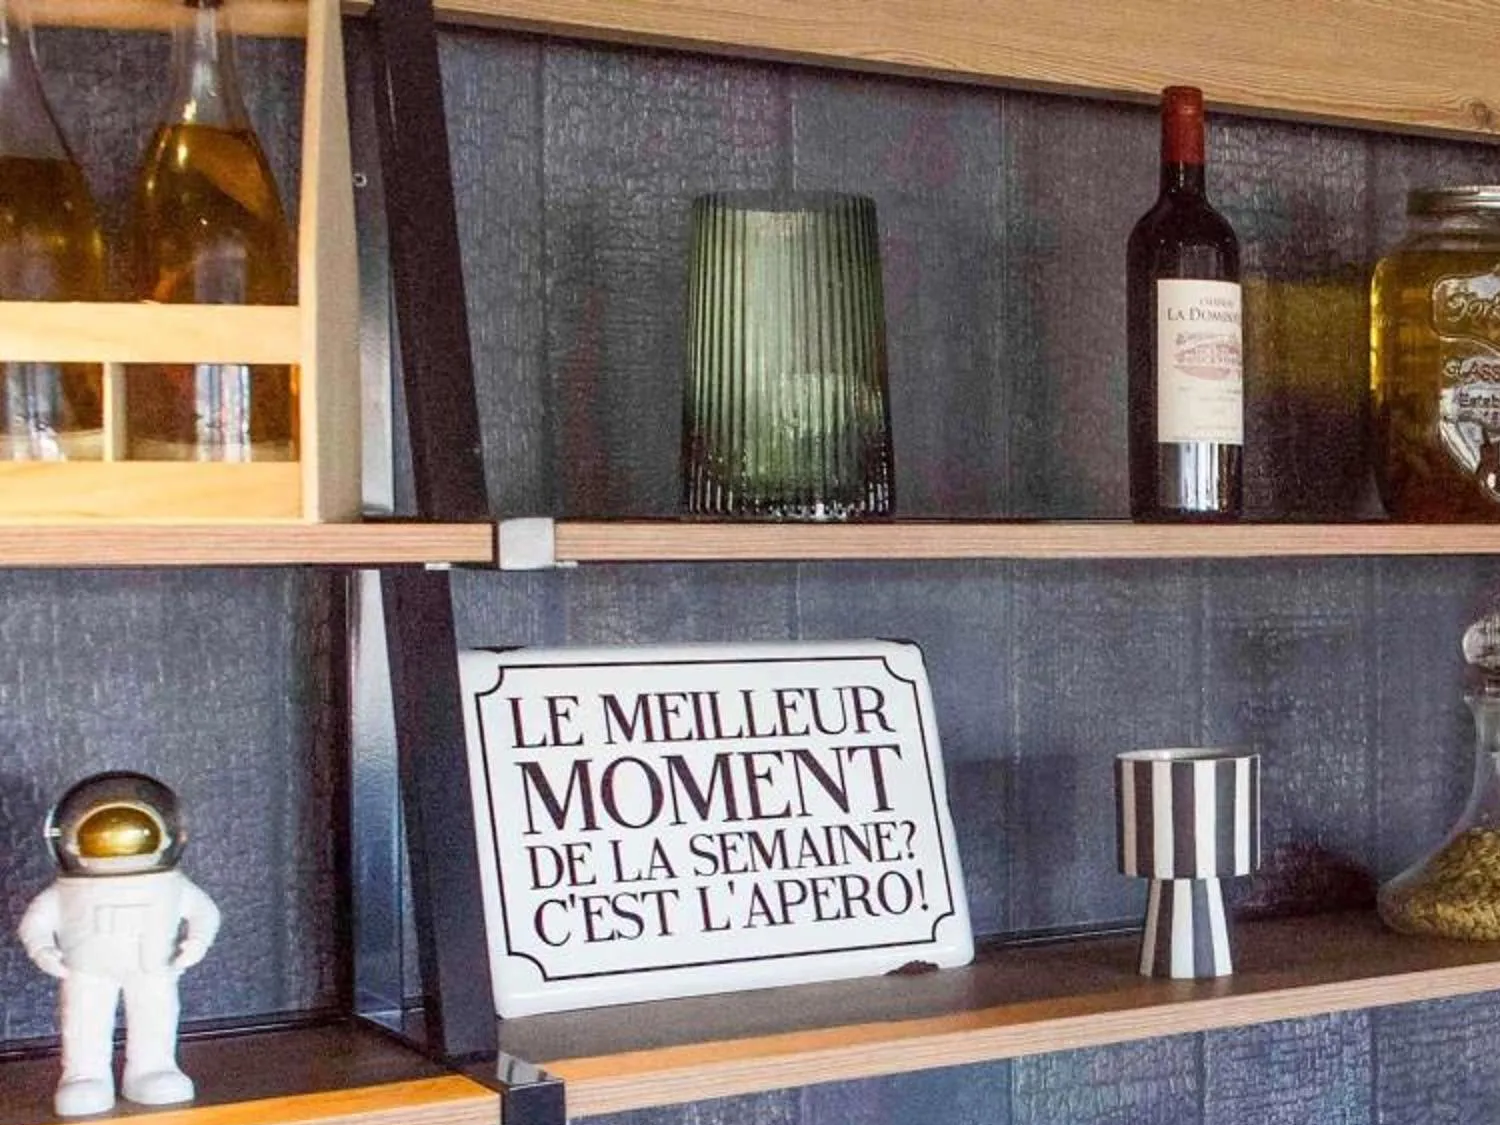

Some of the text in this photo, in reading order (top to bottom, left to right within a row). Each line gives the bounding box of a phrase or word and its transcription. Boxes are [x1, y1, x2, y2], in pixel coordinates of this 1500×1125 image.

[508, 685, 896, 749] LE MEILLEUR
[514, 744, 902, 835] MOMENT
[525, 819, 917, 891] DE LA SEMAINE?
[533, 867, 930, 948] C'EST L'APERO!
